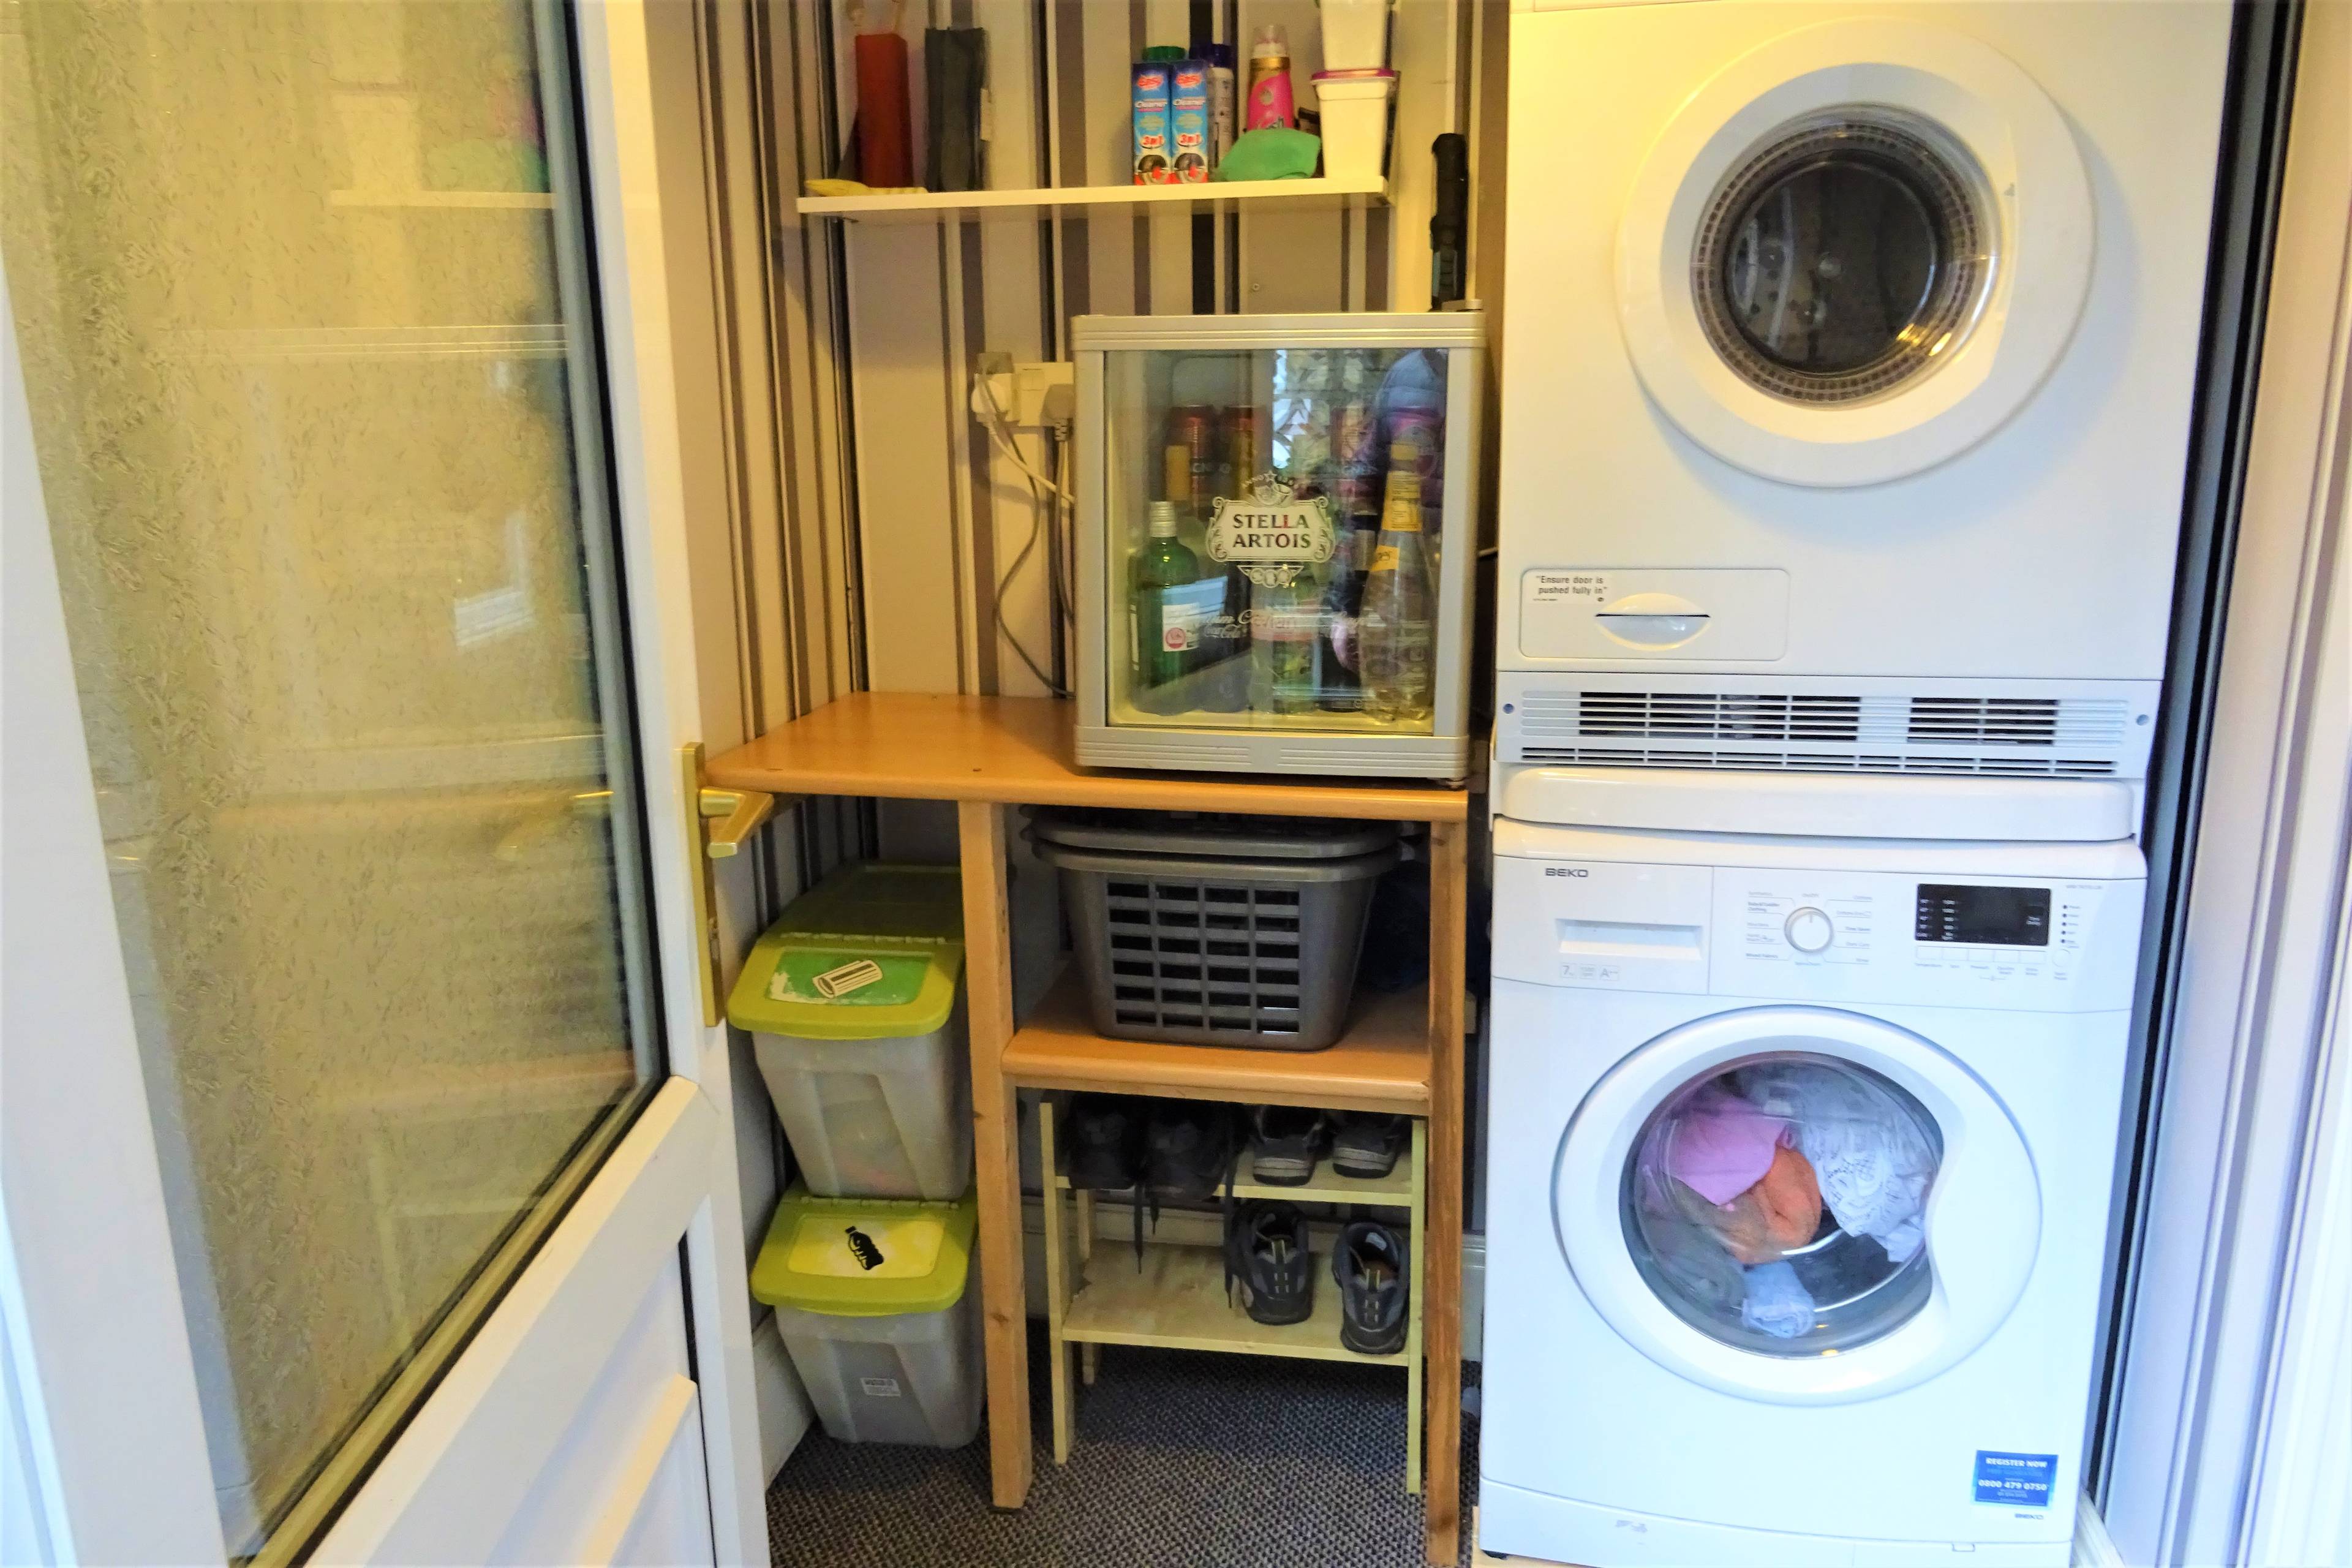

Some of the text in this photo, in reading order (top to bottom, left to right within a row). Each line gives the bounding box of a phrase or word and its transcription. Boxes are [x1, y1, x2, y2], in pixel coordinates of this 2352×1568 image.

[1232, 513, 1310, 529] STELLA
[1232, 533, 1311, 549] ARTOIS
[1572, 576, 1593, 584] door
[1537, 586, 1570, 595] pushed
[1572, 586, 1592, 596] fully
[1545, 867, 1589, 878] BEKO
[1986, 1458, 2025, 1466] REGISTER
[1978, 1479, 2003, 1488] 0800
[2003, 1481, 2022, 1490] 479
